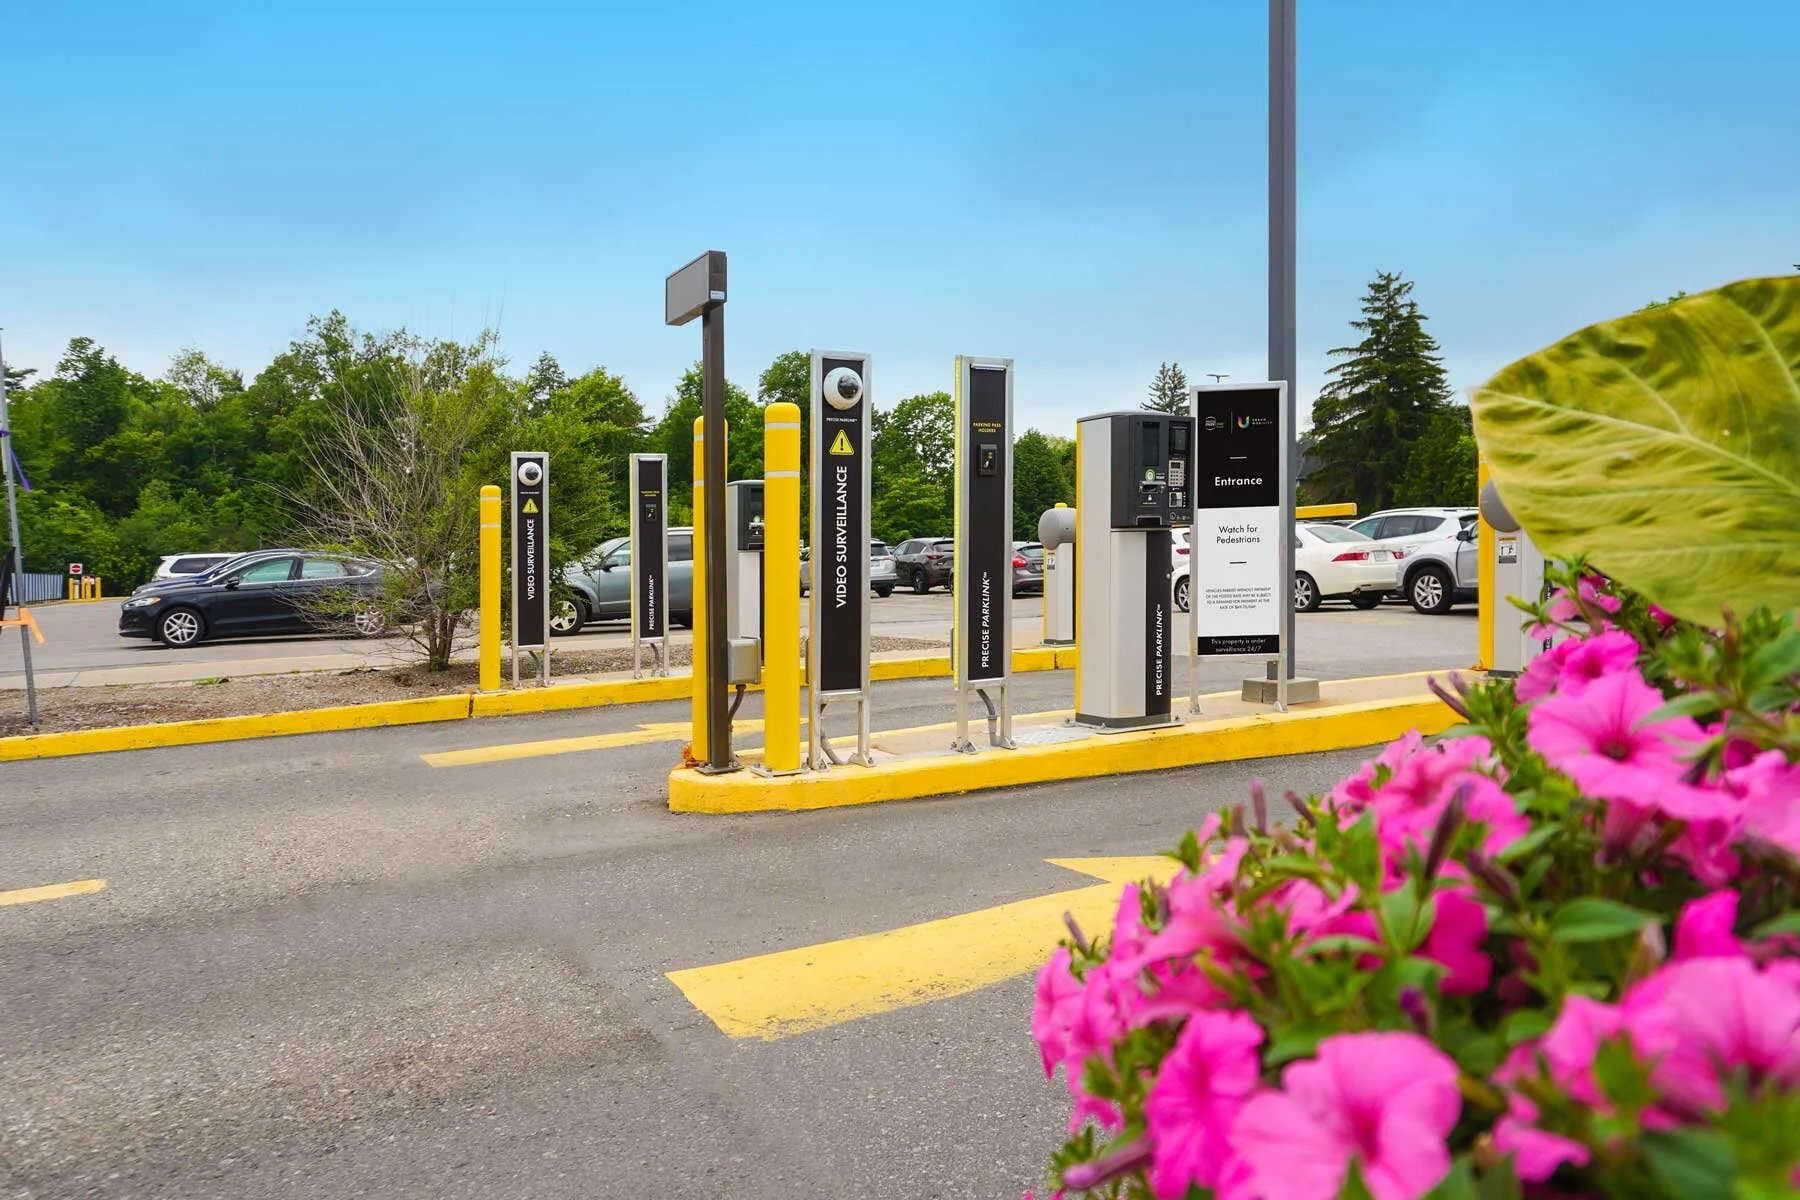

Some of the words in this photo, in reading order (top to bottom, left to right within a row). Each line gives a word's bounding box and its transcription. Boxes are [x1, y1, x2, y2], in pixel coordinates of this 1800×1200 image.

[1214, 476, 1262, 486] Entrance
[836, 465, 848, 562] SURVEILLANCE
[1218, 524, 1244, 534] Watch
[1246, 524, 1258, 532] for
[1216, 536, 1260, 544] Pedestrians
[836, 565, 848, 608] VIDEO
